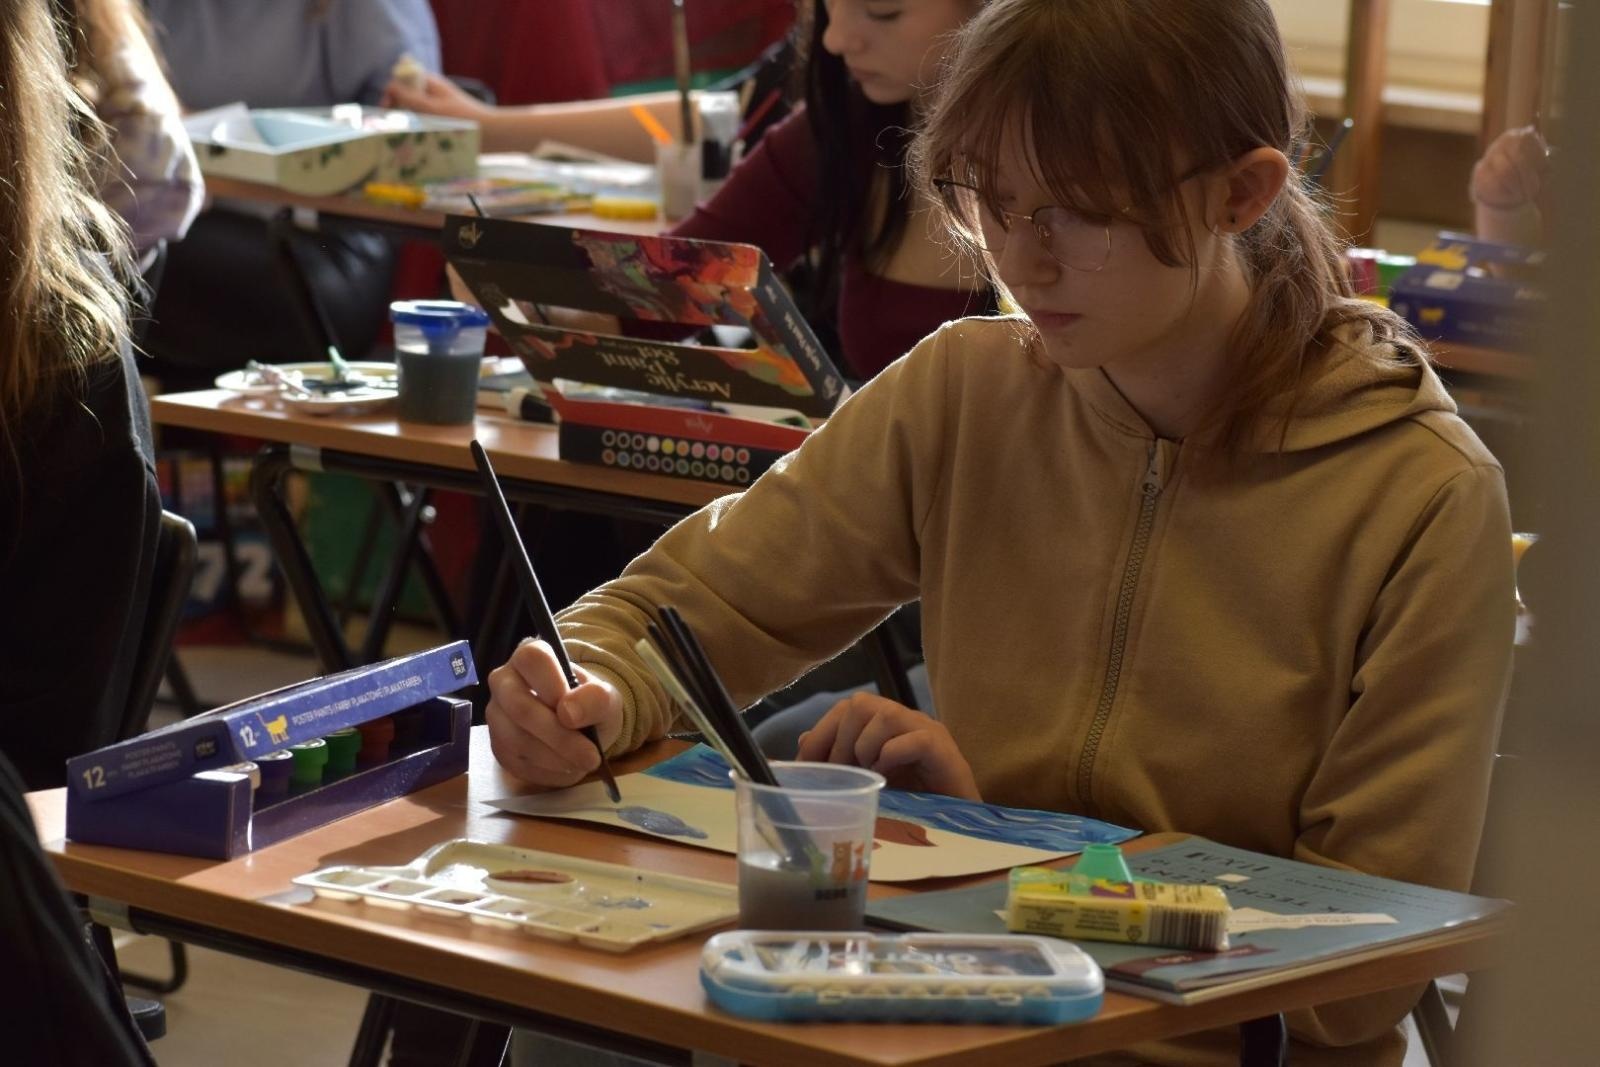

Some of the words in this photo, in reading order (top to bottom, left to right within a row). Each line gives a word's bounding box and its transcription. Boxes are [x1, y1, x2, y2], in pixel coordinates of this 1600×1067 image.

[291, 711, 315, 726] POSTER
[239, 723, 257, 748] 12
[82, 765, 107, 790] 12
